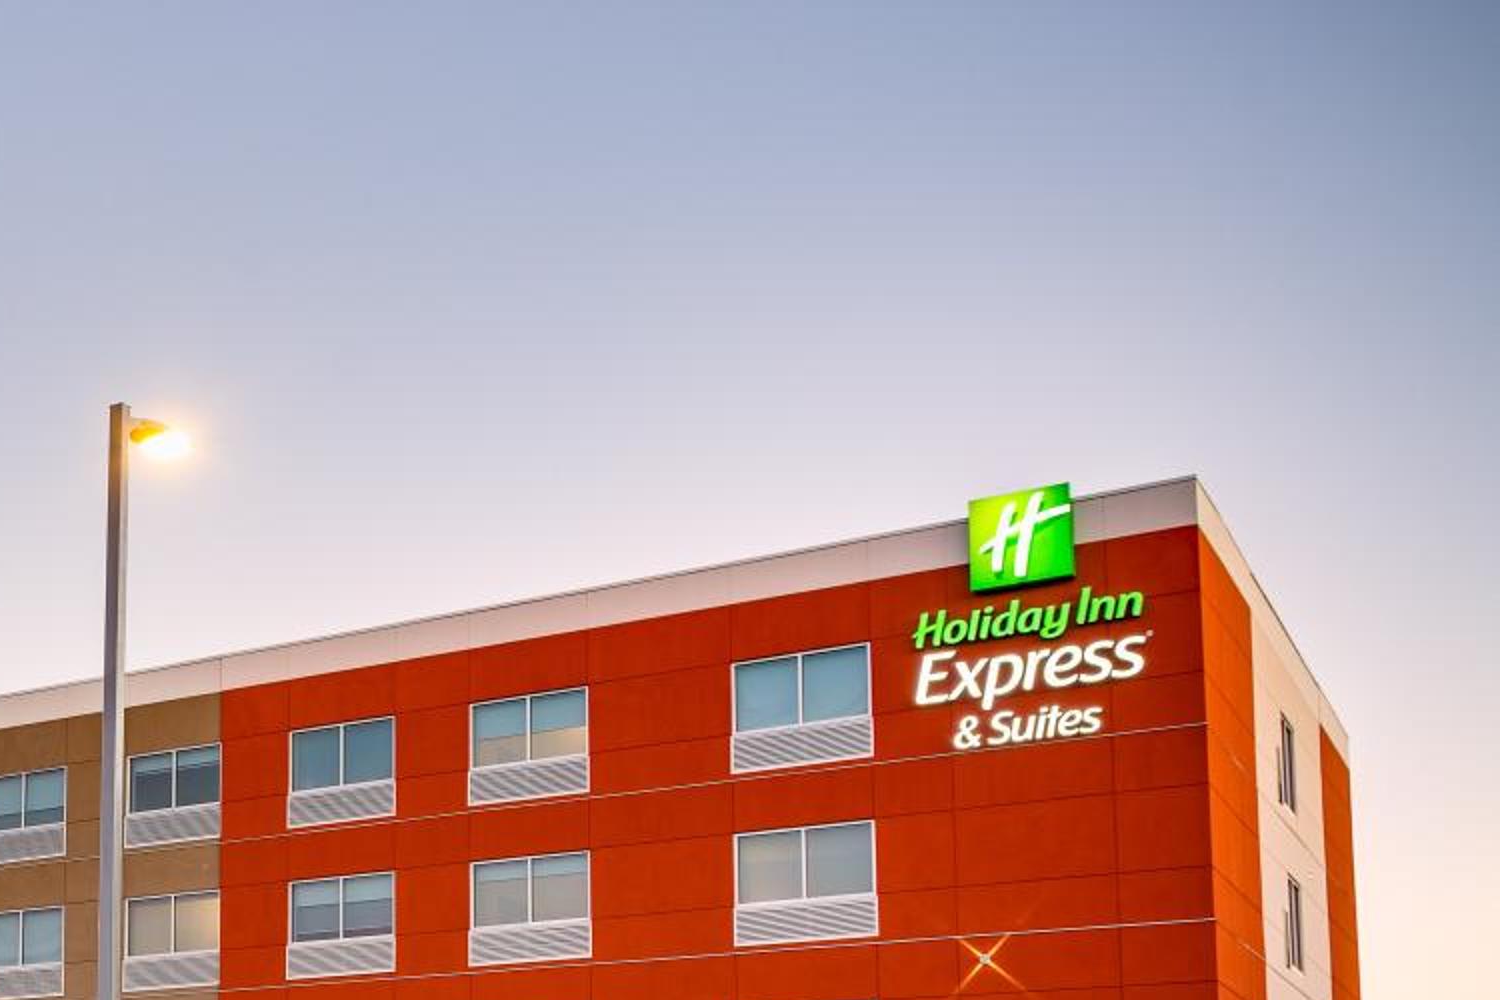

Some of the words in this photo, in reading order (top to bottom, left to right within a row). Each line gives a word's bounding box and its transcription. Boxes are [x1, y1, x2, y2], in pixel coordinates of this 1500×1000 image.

[912, 599, 1070, 649] Holiday
[1076, 586, 1144, 625] Inn
[914, 634, 1148, 711] Express
[953, 715, 981, 750] &
[987, 704, 1103, 746] Suites
